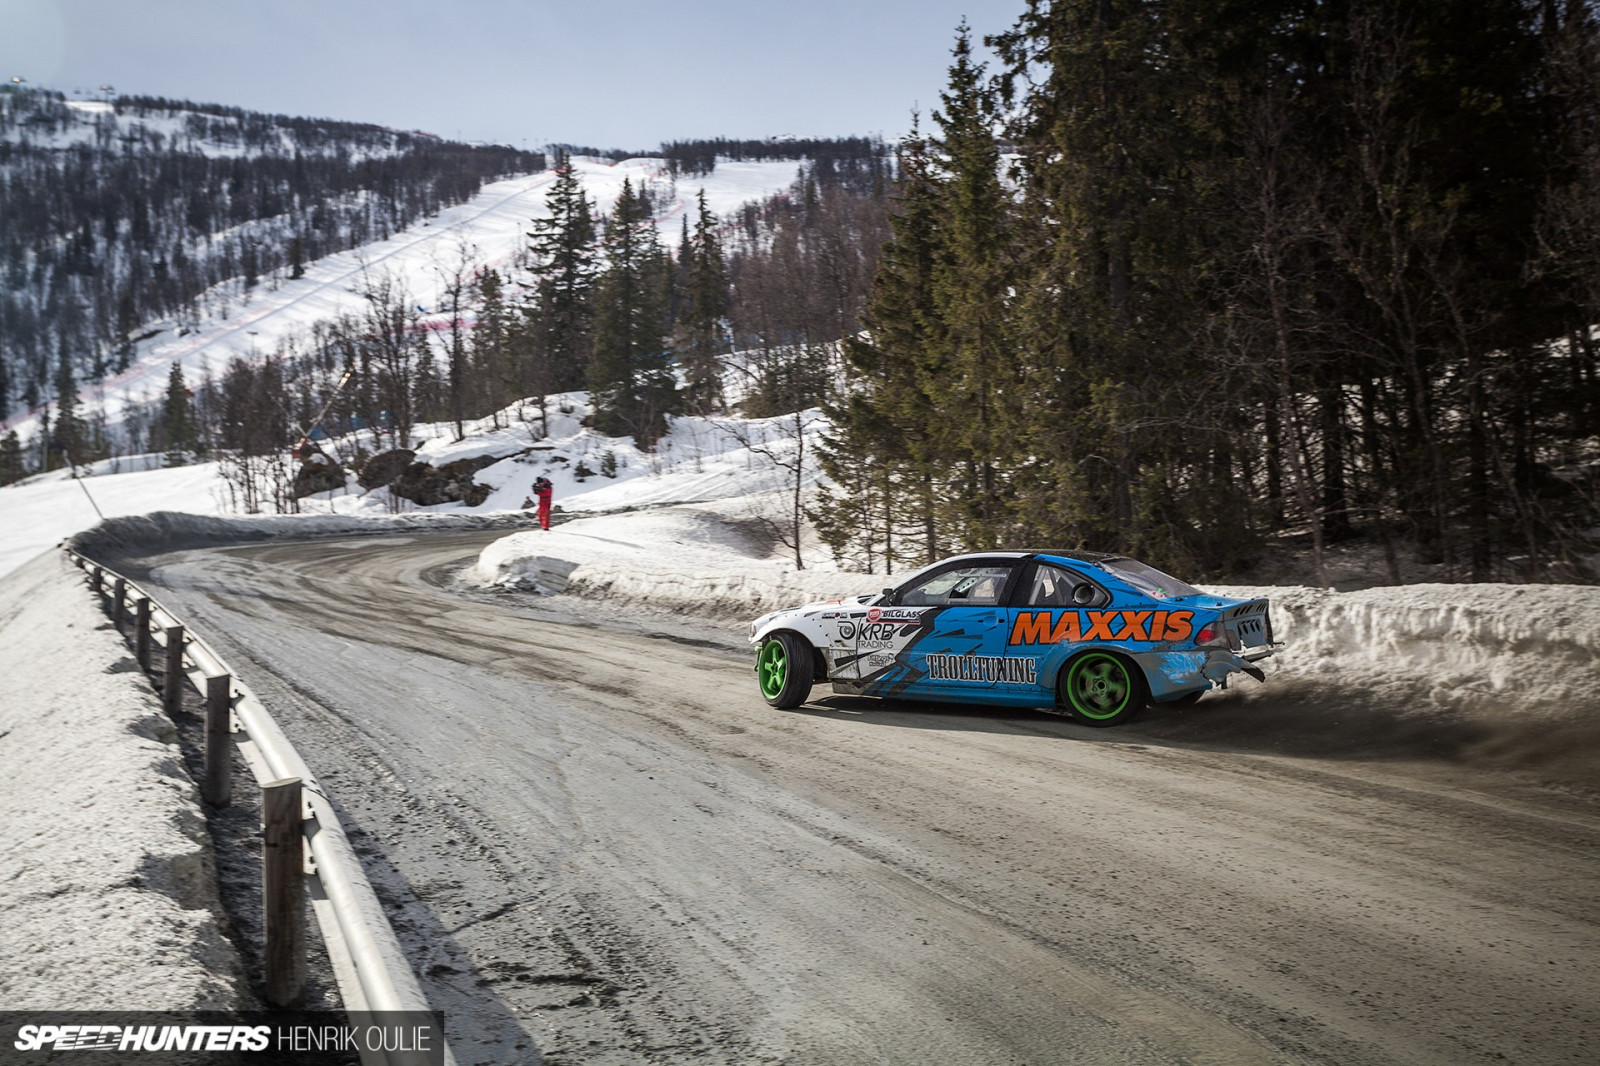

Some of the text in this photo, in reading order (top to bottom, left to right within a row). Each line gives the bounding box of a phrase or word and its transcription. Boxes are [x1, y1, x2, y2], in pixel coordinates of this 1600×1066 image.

[883, 611, 921, 619] BILGLASS
[858, 623, 894, 640] KRB
[1009, 610, 1196, 645] MAXXIS
[858, 641, 893, 649] TRADING
[926, 654, 1037, 685] TROLLTUNING
